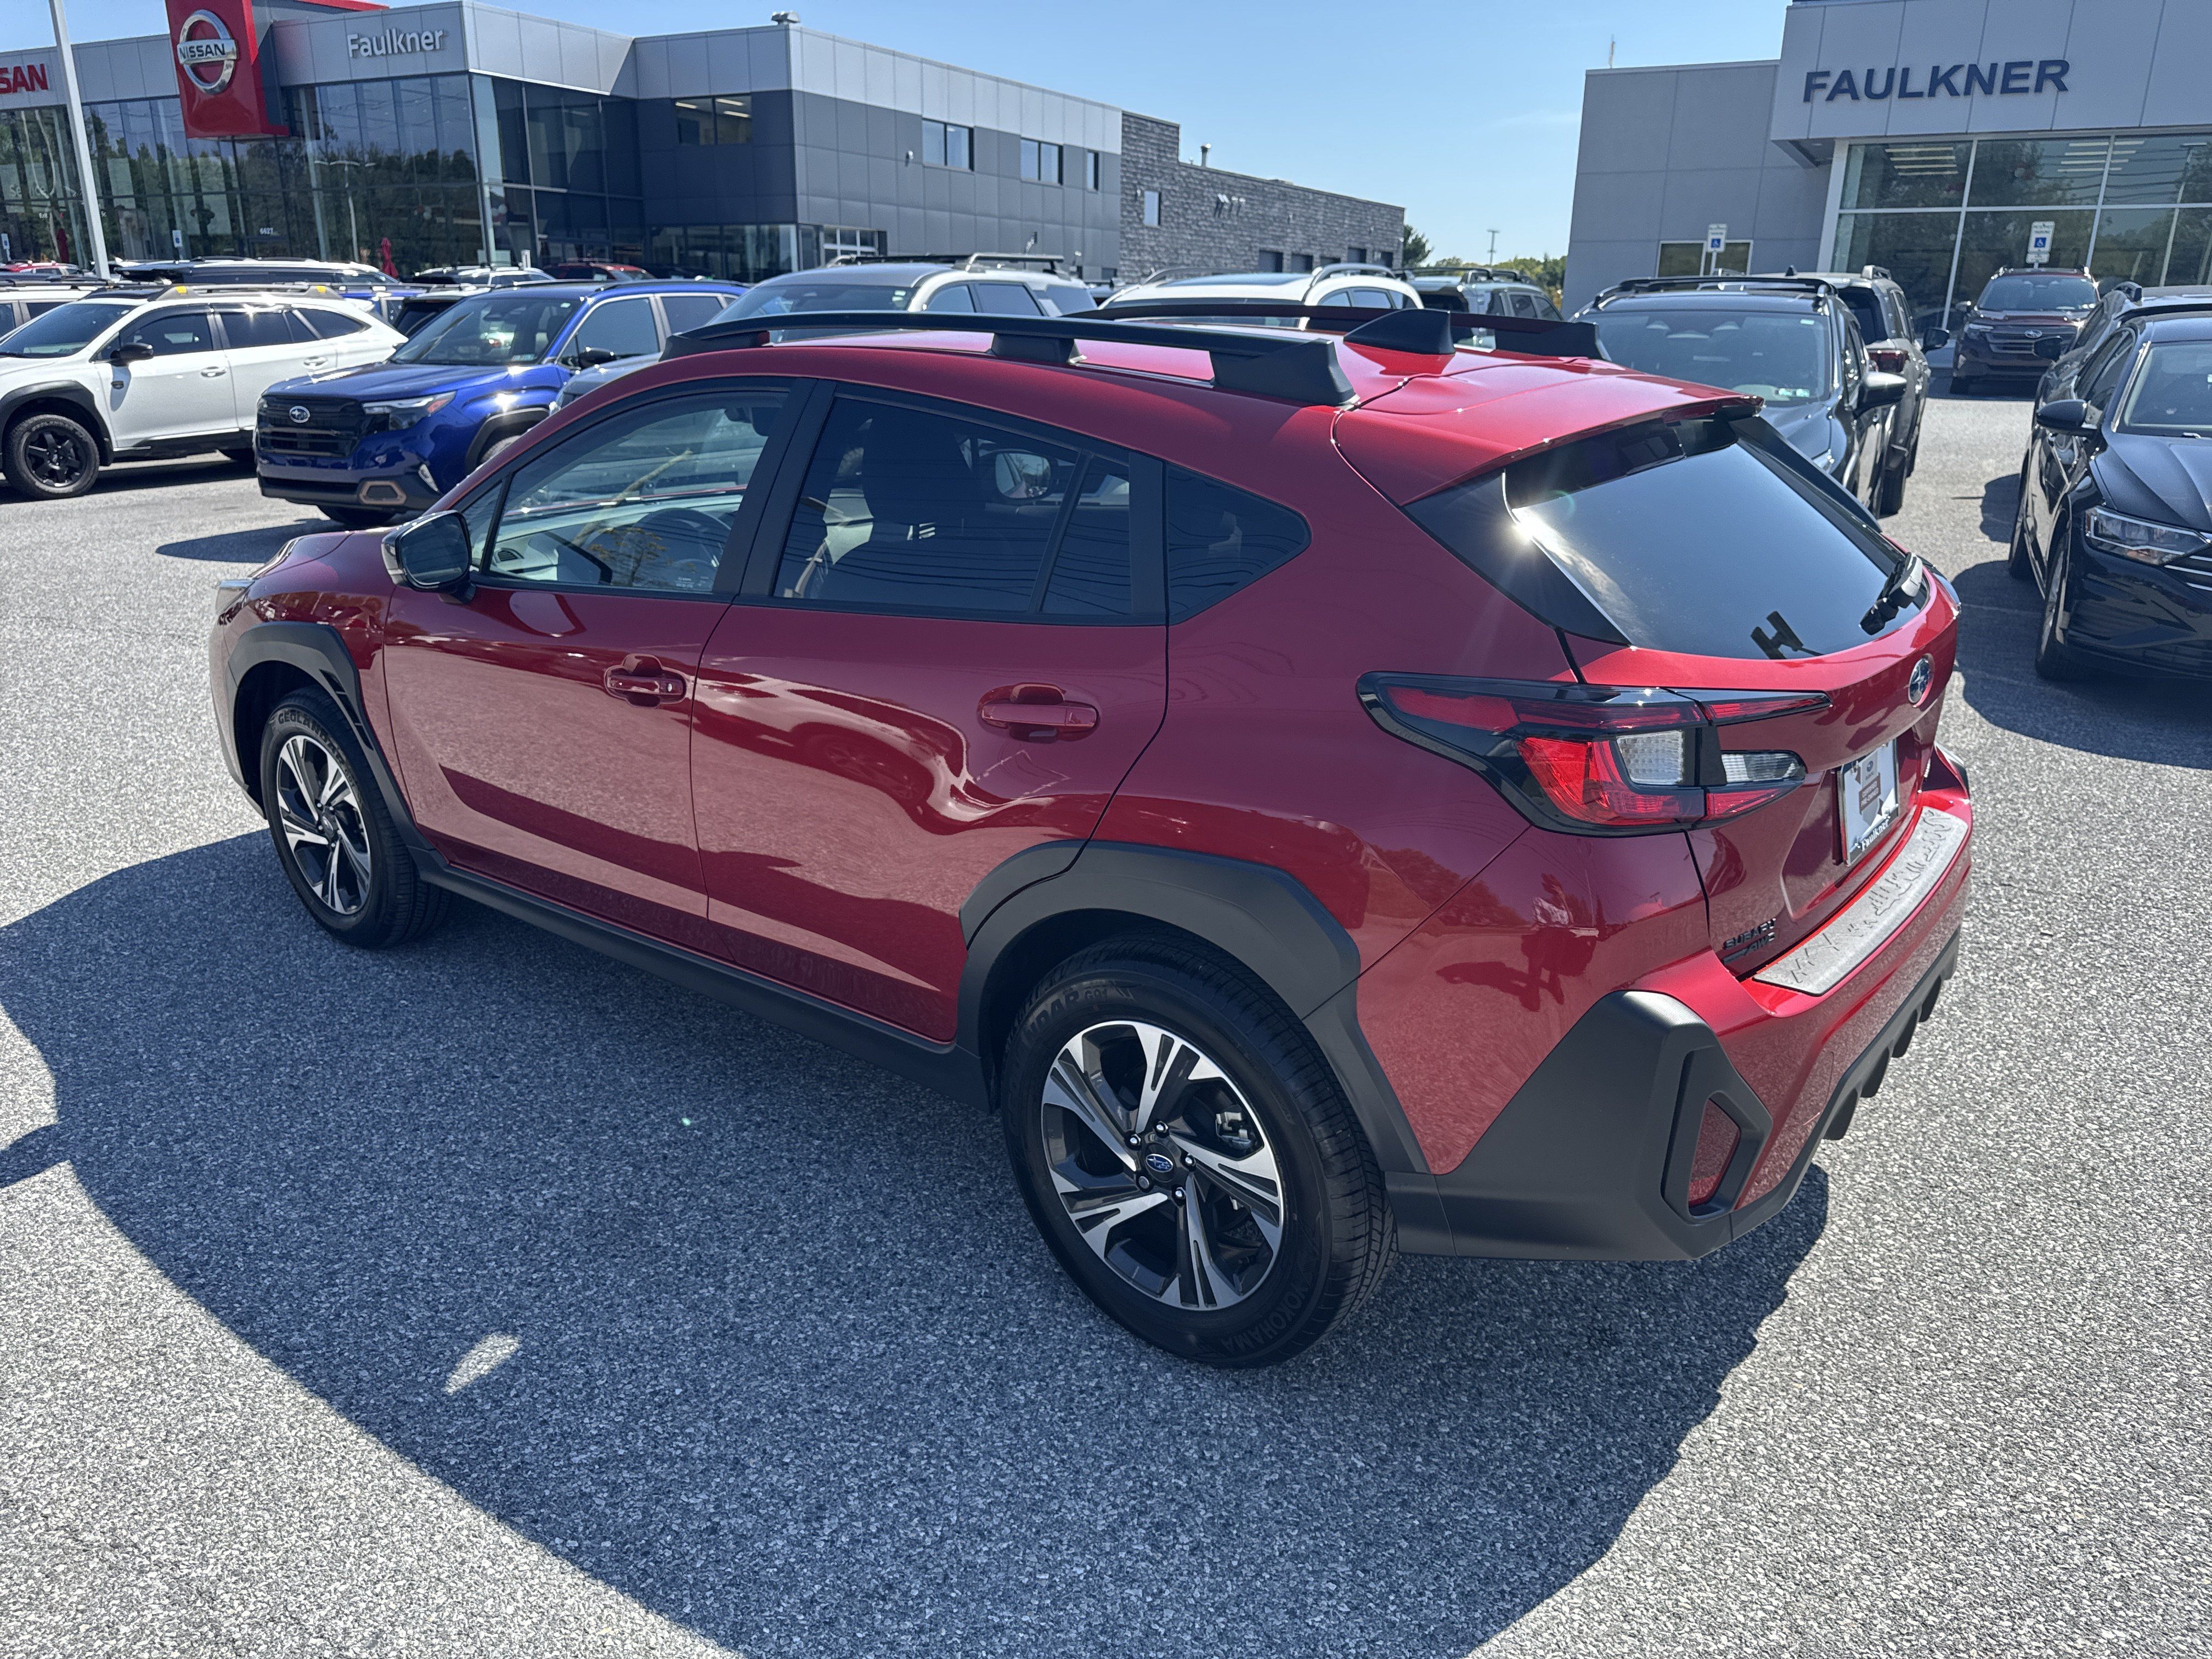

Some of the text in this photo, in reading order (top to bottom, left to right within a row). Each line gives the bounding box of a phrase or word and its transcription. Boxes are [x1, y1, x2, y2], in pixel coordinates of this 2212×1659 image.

[179, 43, 225, 59] NISSAN
[348, 27, 444, 58] Faulkner
[1803, 59, 2070, 103] FAULKNER
[278, 709, 345, 765] GEOLANDAR
[1861, 819, 1889, 851] Faulkner
[1722, 917, 1776, 950] SUBARU
[1220, 1283, 1309, 1354] YOKOHAMA
